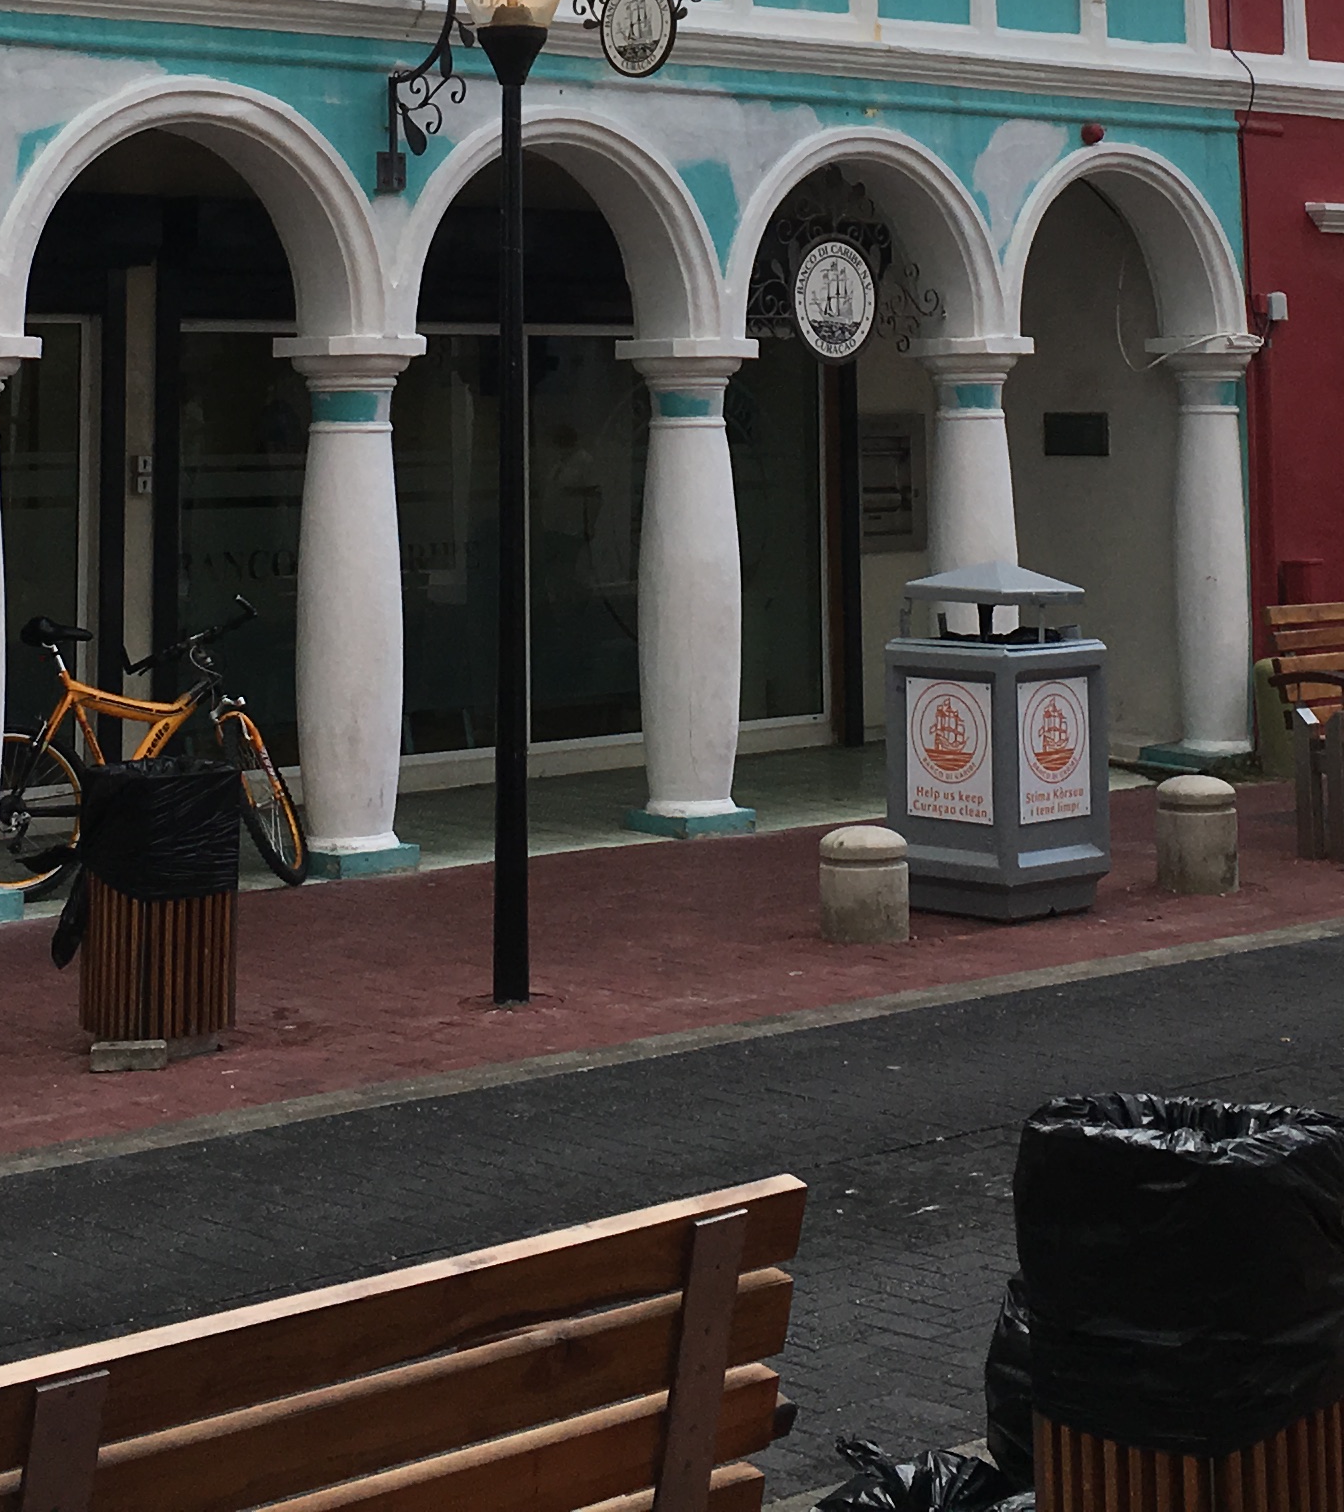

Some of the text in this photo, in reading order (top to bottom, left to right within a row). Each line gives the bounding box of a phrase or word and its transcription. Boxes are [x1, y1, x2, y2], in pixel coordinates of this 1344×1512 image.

[797, 254, 817, 295] BANCO
[818, 245, 828, 257] DI
[830, 244, 863, 269] CARIBE
[814, 338, 857, 355] CURAÇAO
[922, 757, 944, 778] BANCO
[916, 786, 984, 806] Help us keep
[1026, 790, 1051, 805] Stima
[913, 799, 988, 818] Curaçao clean
[1036, 802, 1055, 816] tené
[1057, 801, 1080, 815] limpi
